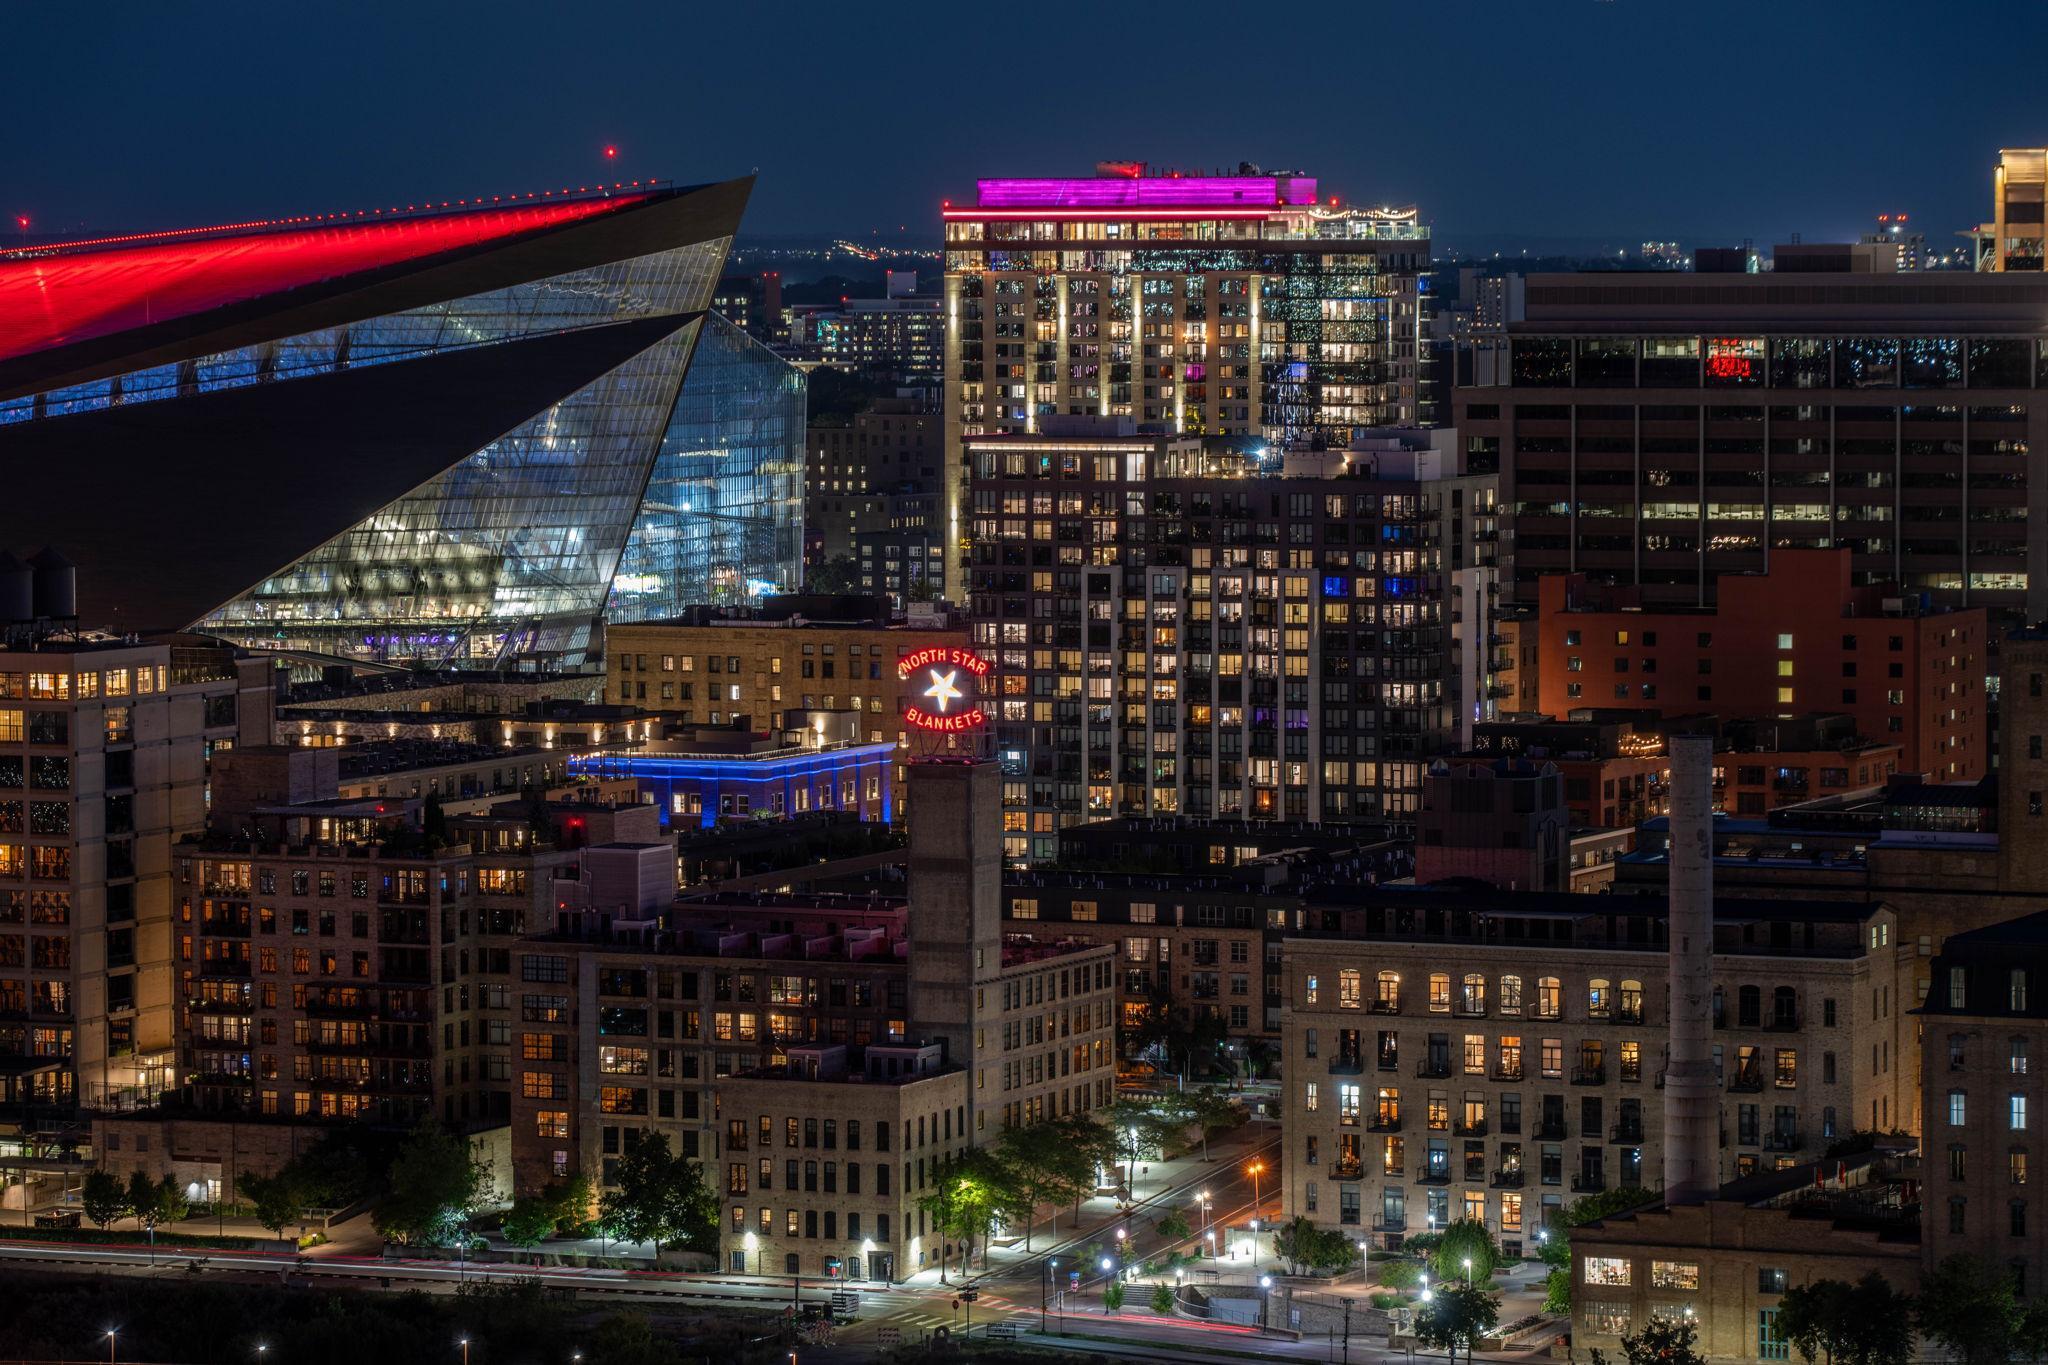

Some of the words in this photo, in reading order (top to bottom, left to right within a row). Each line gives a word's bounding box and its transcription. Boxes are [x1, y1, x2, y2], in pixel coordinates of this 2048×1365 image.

[900, 648, 946, 673] NORTH
[952, 650, 987, 675] STAR
[906, 708, 982, 730] BLANKETS
